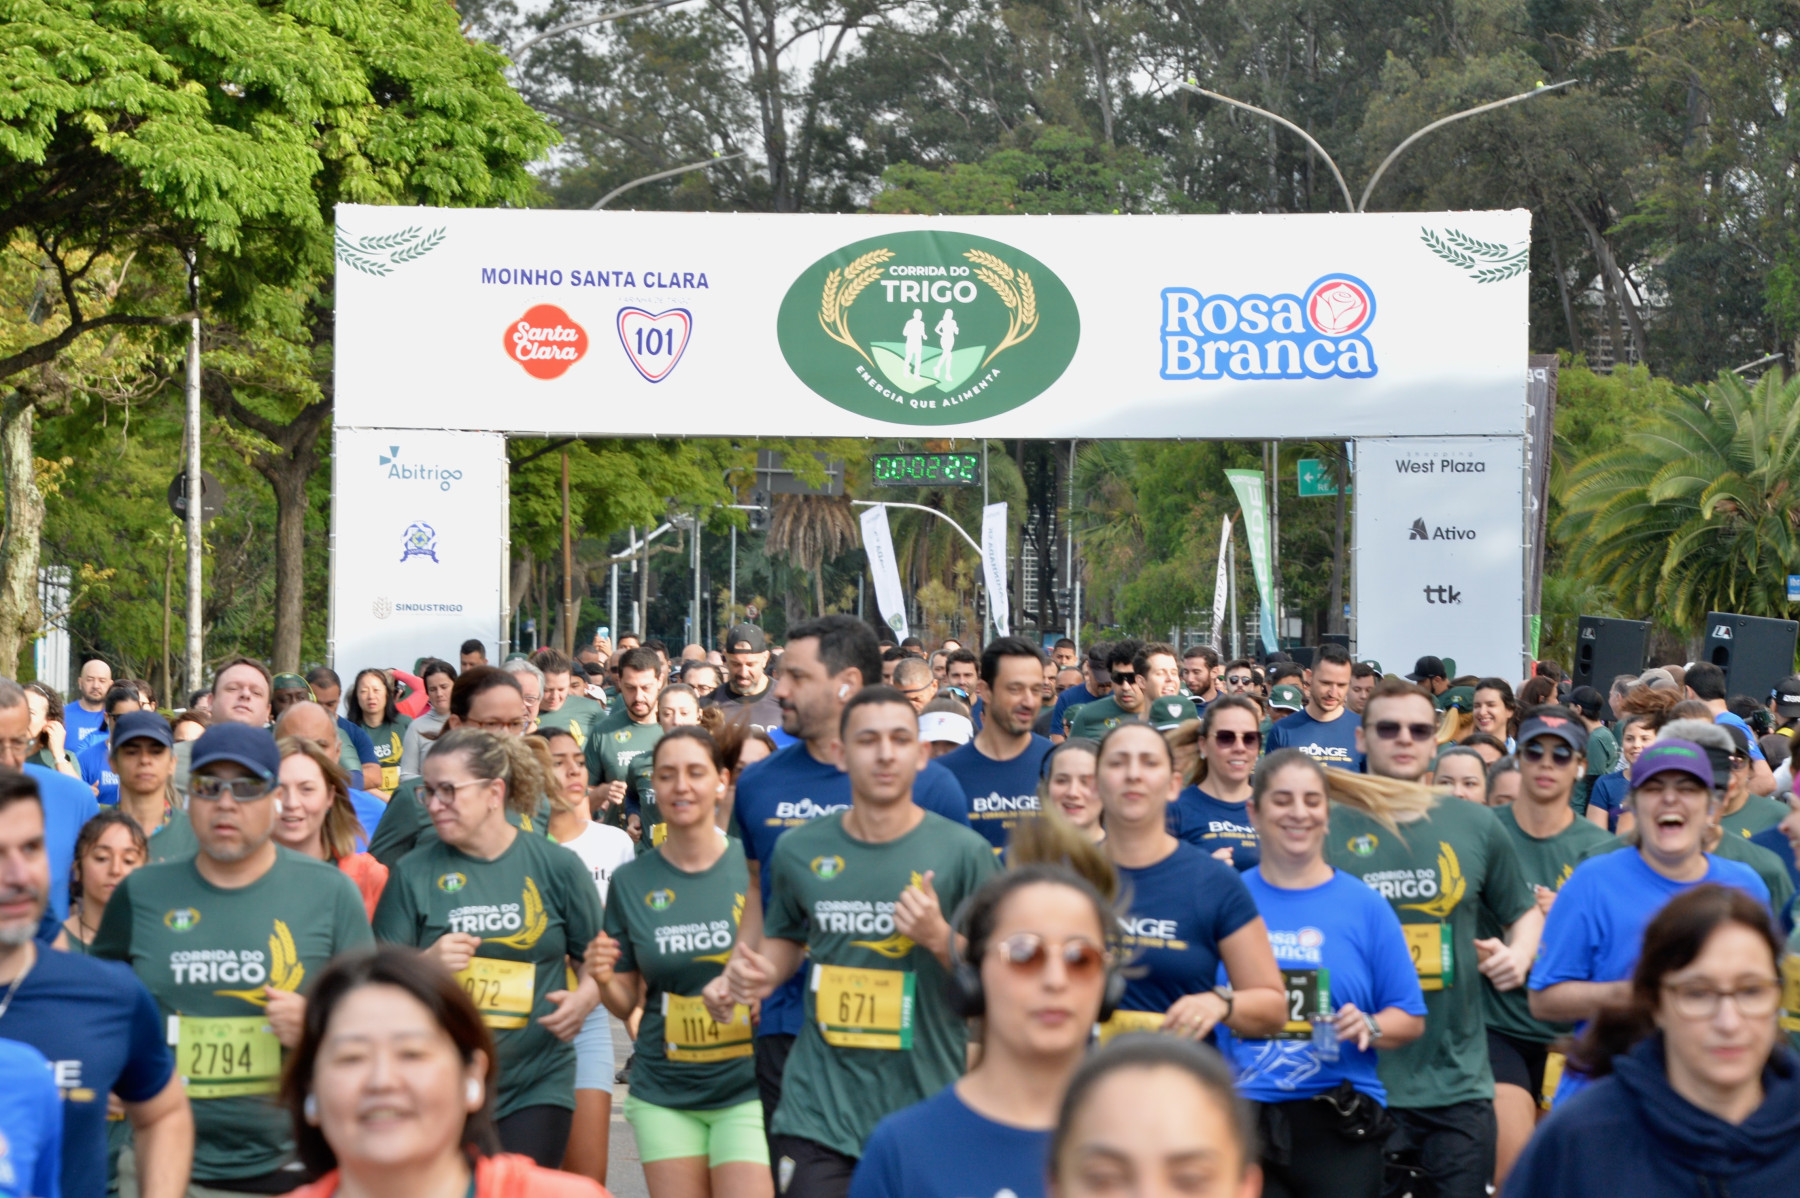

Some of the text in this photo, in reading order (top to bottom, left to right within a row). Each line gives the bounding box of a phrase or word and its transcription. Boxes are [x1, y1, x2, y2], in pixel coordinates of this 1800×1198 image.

[481, 268, 709, 289] MOINHO SANTA CLARA
[889, 265, 970, 277] CORRIDA DO
[880, 279, 978, 303] TRIGO
[1164, 292, 1306, 336] Rosa
[512, 321, 579, 344] Santa
[635, 327, 673, 355] 101
[515, 340, 578, 361] Clara
[1164, 335, 1373, 375] Branca
[855, 365, 1001, 409] ENERGIA QUE ALIMENTA
[1395, 459, 1486, 473] West Plaza
[388, 463, 463, 491] Abitrigo
[1432, 526, 1476, 540] Ativo
[1423, 585, 1463, 604] ttk
[395, 603, 463, 612] SINDUSTRIGO
[775, 797, 855, 819] BUN
[973, 791, 1042, 812] BUNGE
[1208, 820, 1256, 833] BUN
[1416, 868, 1435, 879] DO
[501, 903, 520, 912] DO
[814, 901, 896, 913] CORRIDA DO
[448, 912, 522, 933] TRIGO
[654, 920, 730, 937] CORRIDA DO
[815, 912, 896, 934] TRIGO
[1116, 917, 1178, 940] NGE
[654, 930, 732, 955] TRIGO
[170, 950, 265, 963] CORRIDA DO
[170, 961, 266, 984] TRIGO
[839, 991, 876, 1024] 671
[682, 1016, 719, 1043] 1114
[191, 1041, 253, 1075] 2794
